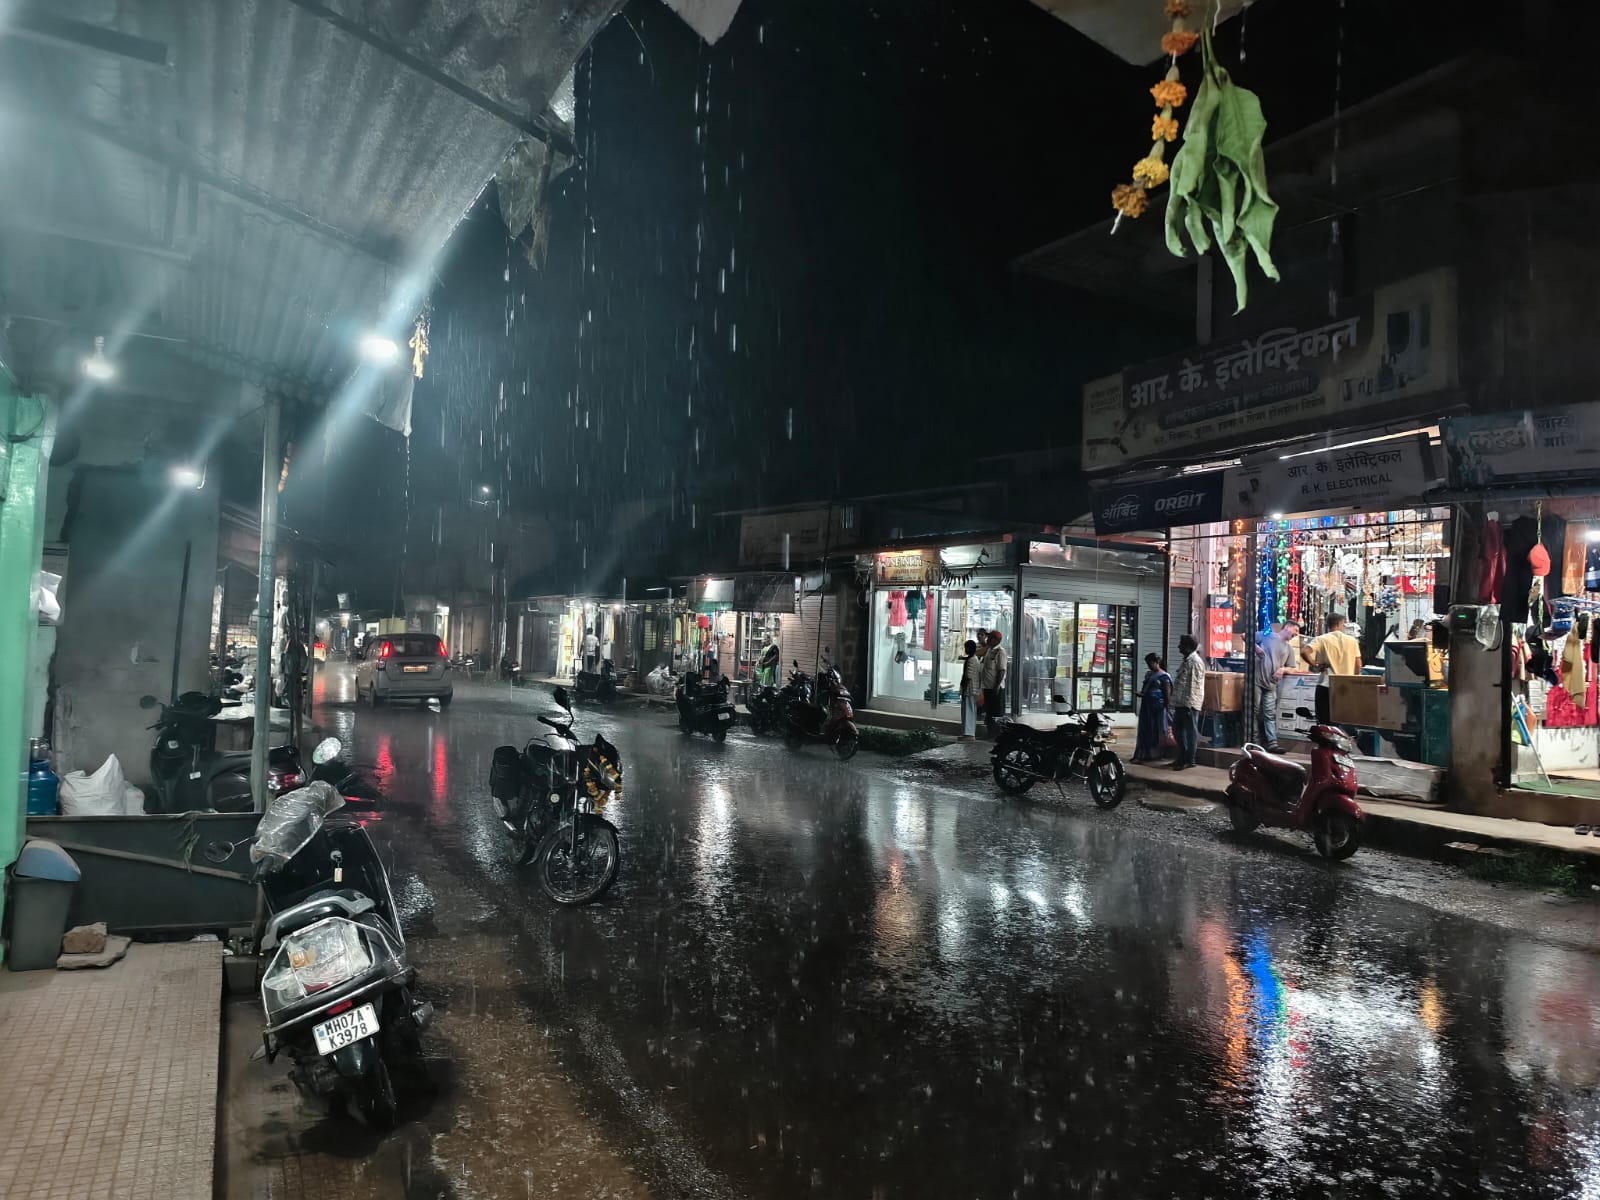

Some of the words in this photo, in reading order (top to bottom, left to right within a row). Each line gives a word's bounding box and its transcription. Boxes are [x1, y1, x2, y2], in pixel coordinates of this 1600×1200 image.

[1129, 373, 1174, 408] आर.
[1178, 358, 1208, 392] के.
[1214, 316, 1360, 391] इलेक्ट्रिकल
[1326, 474, 1392, 491] ELECTRICAL
[1154, 492, 1207, 512] ORBIT
